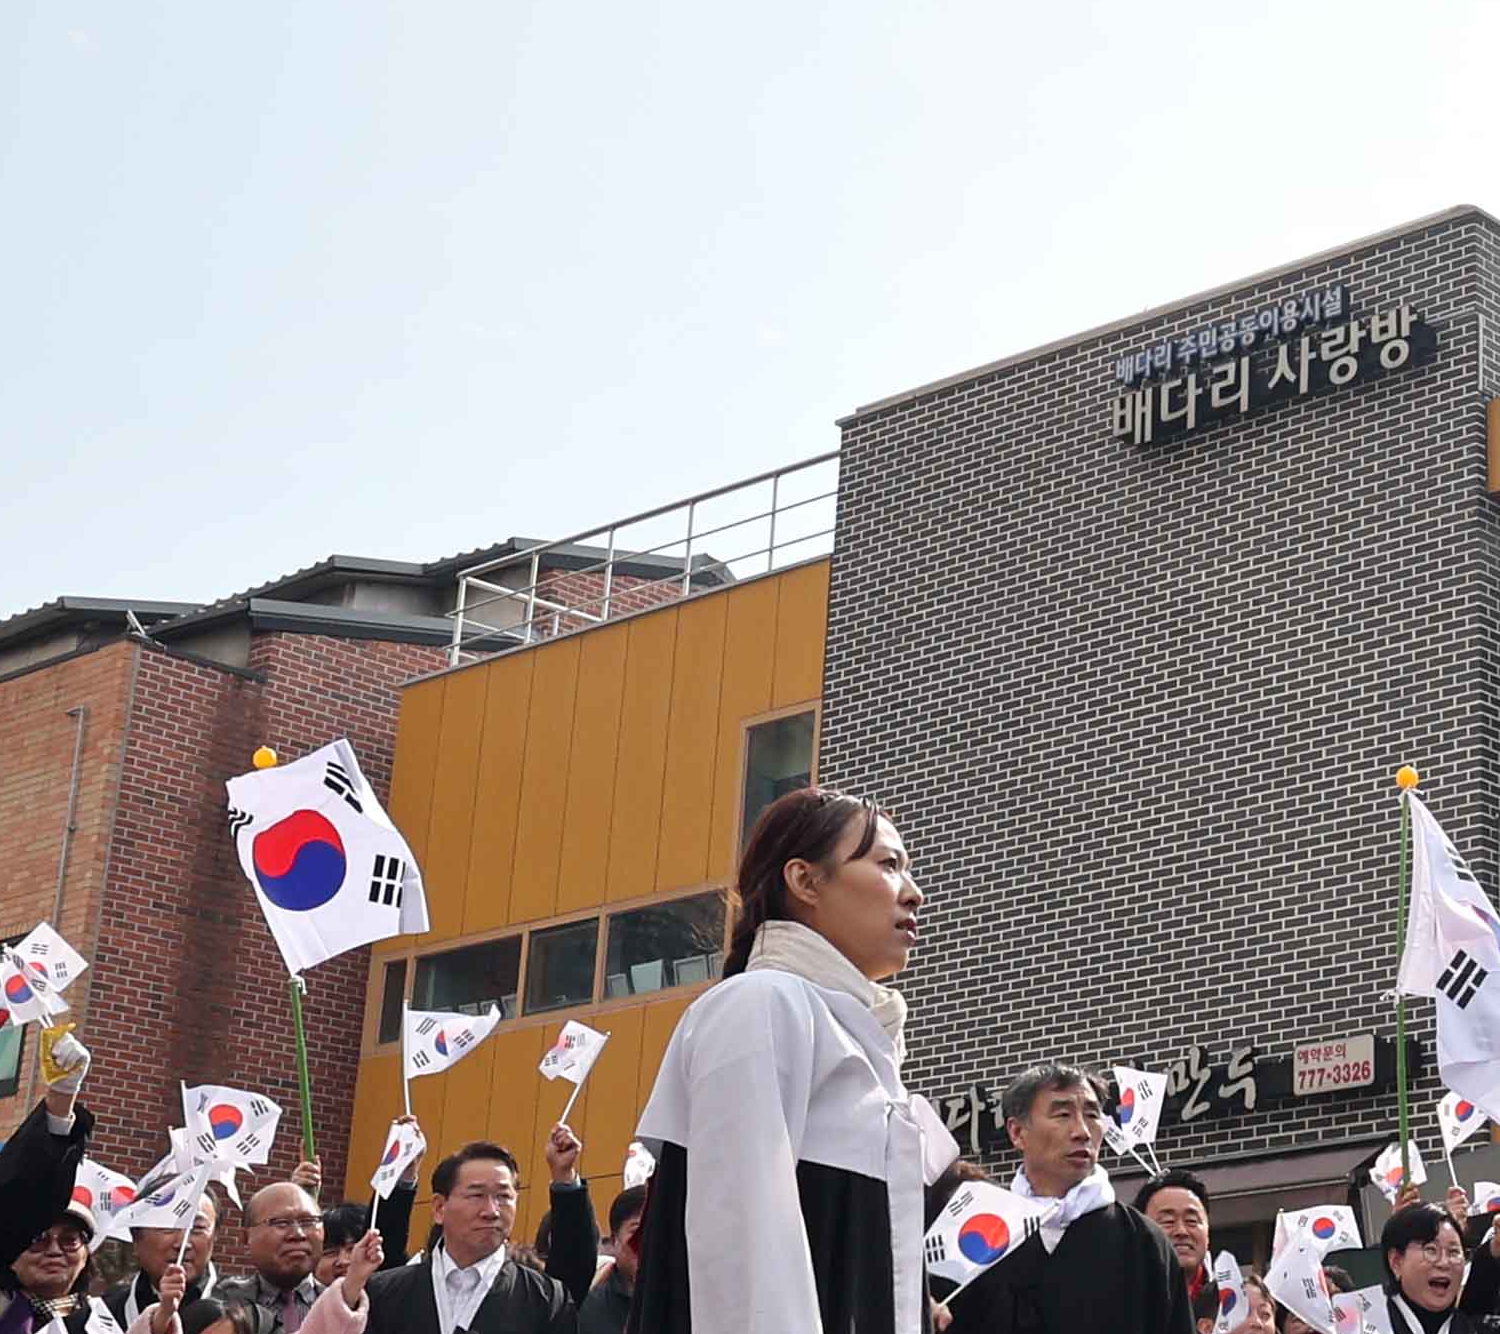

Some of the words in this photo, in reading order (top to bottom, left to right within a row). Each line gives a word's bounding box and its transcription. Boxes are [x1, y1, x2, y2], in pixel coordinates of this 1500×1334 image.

[1112, 355, 1250, 445] 배다리
[1267, 305, 1418, 395] 사랑방
[1116, 340, 1172, 384] 배다리
[1177, 285, 1343, 362] 주민공동이용시설
[1298, 1043, 1347, 1064] 예약문의
